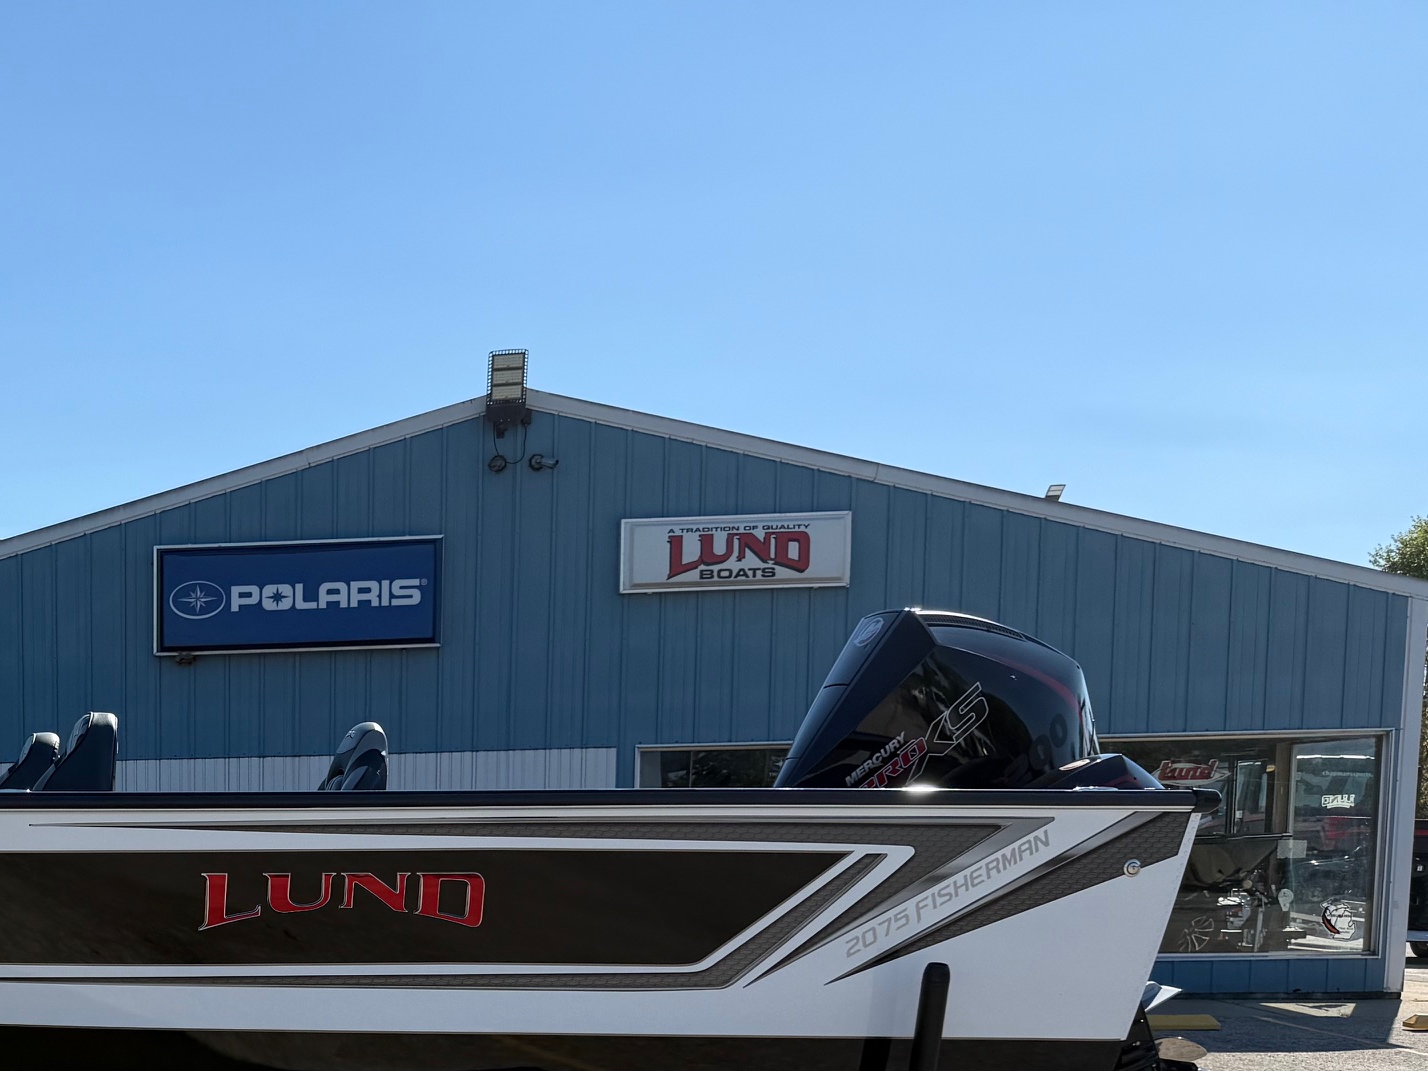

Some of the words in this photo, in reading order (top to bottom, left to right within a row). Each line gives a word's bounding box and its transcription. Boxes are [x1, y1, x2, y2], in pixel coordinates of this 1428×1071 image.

[679, 525, 740, 534] TRADITION
[762, 523, 811, 531] QUALITY
[666, 530, 811, 581] LUND
[699, 566, 776, 580] BOATS
[230, 578, 422, 612] POLARIS
[845, 731, 905, 787] MERCURY
[198, 872, 486, 931] LUND
[844, 907, 910, 959] 2075
[915, 829, 1050, 924] FISHERMAN
